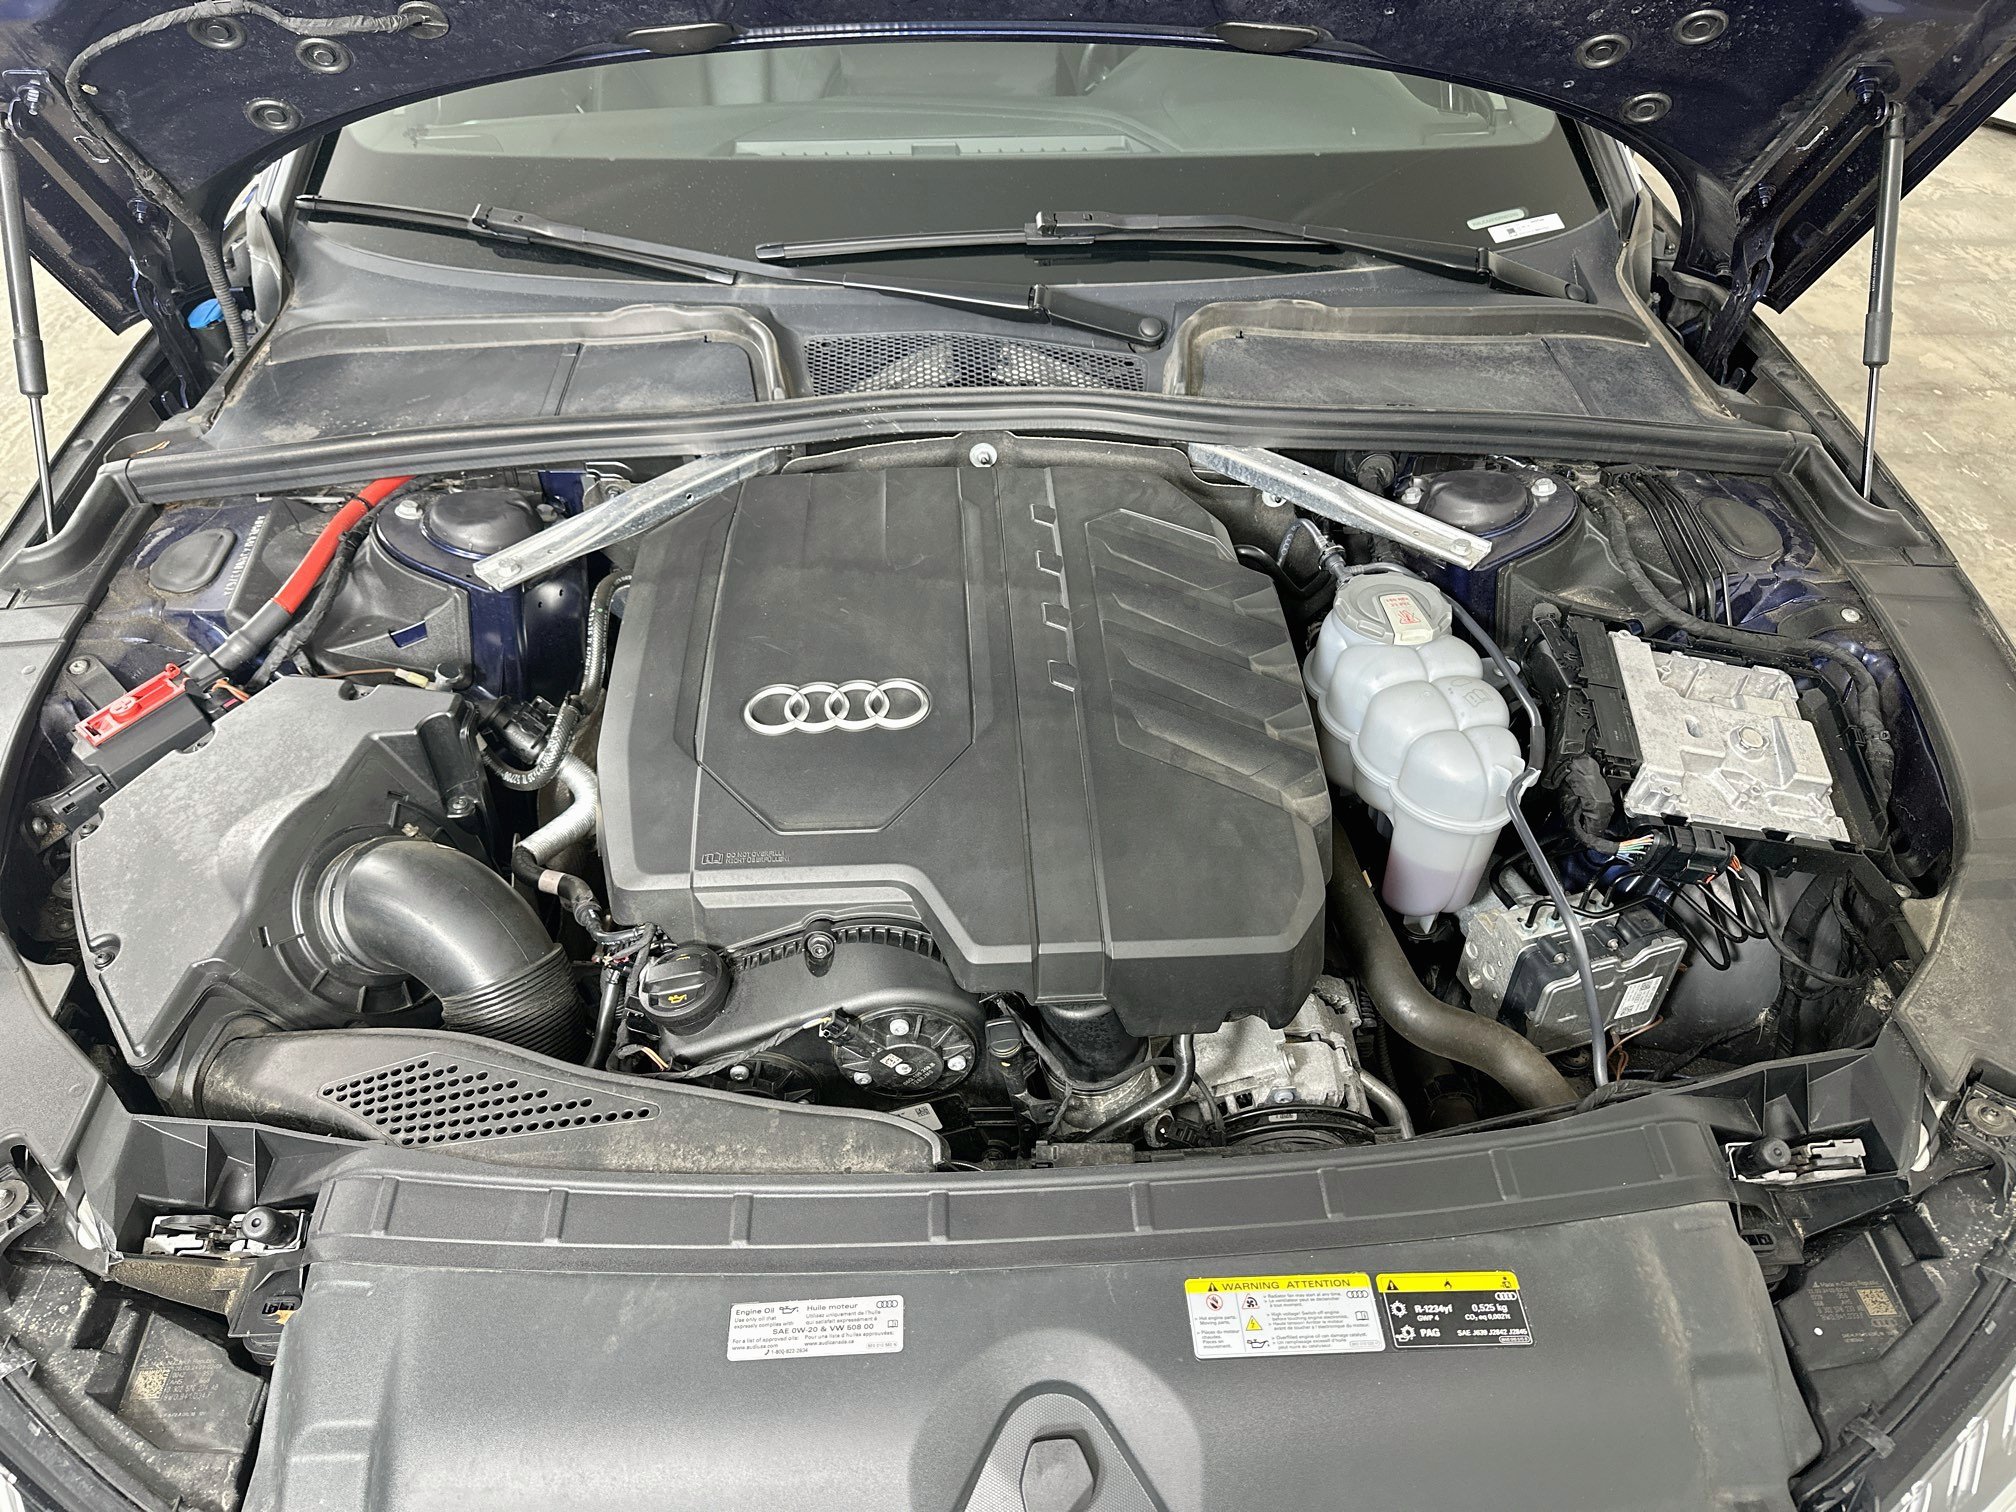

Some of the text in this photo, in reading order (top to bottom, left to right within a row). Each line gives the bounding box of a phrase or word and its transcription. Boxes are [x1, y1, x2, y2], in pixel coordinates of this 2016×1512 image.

[1222, 1279, 1351, 1291] WARNING ATTENTION
[1414, 1303, 1508, 1314] R-1234yf 0,525 kg
[1419, 1328, 1440, 1338] PAG
